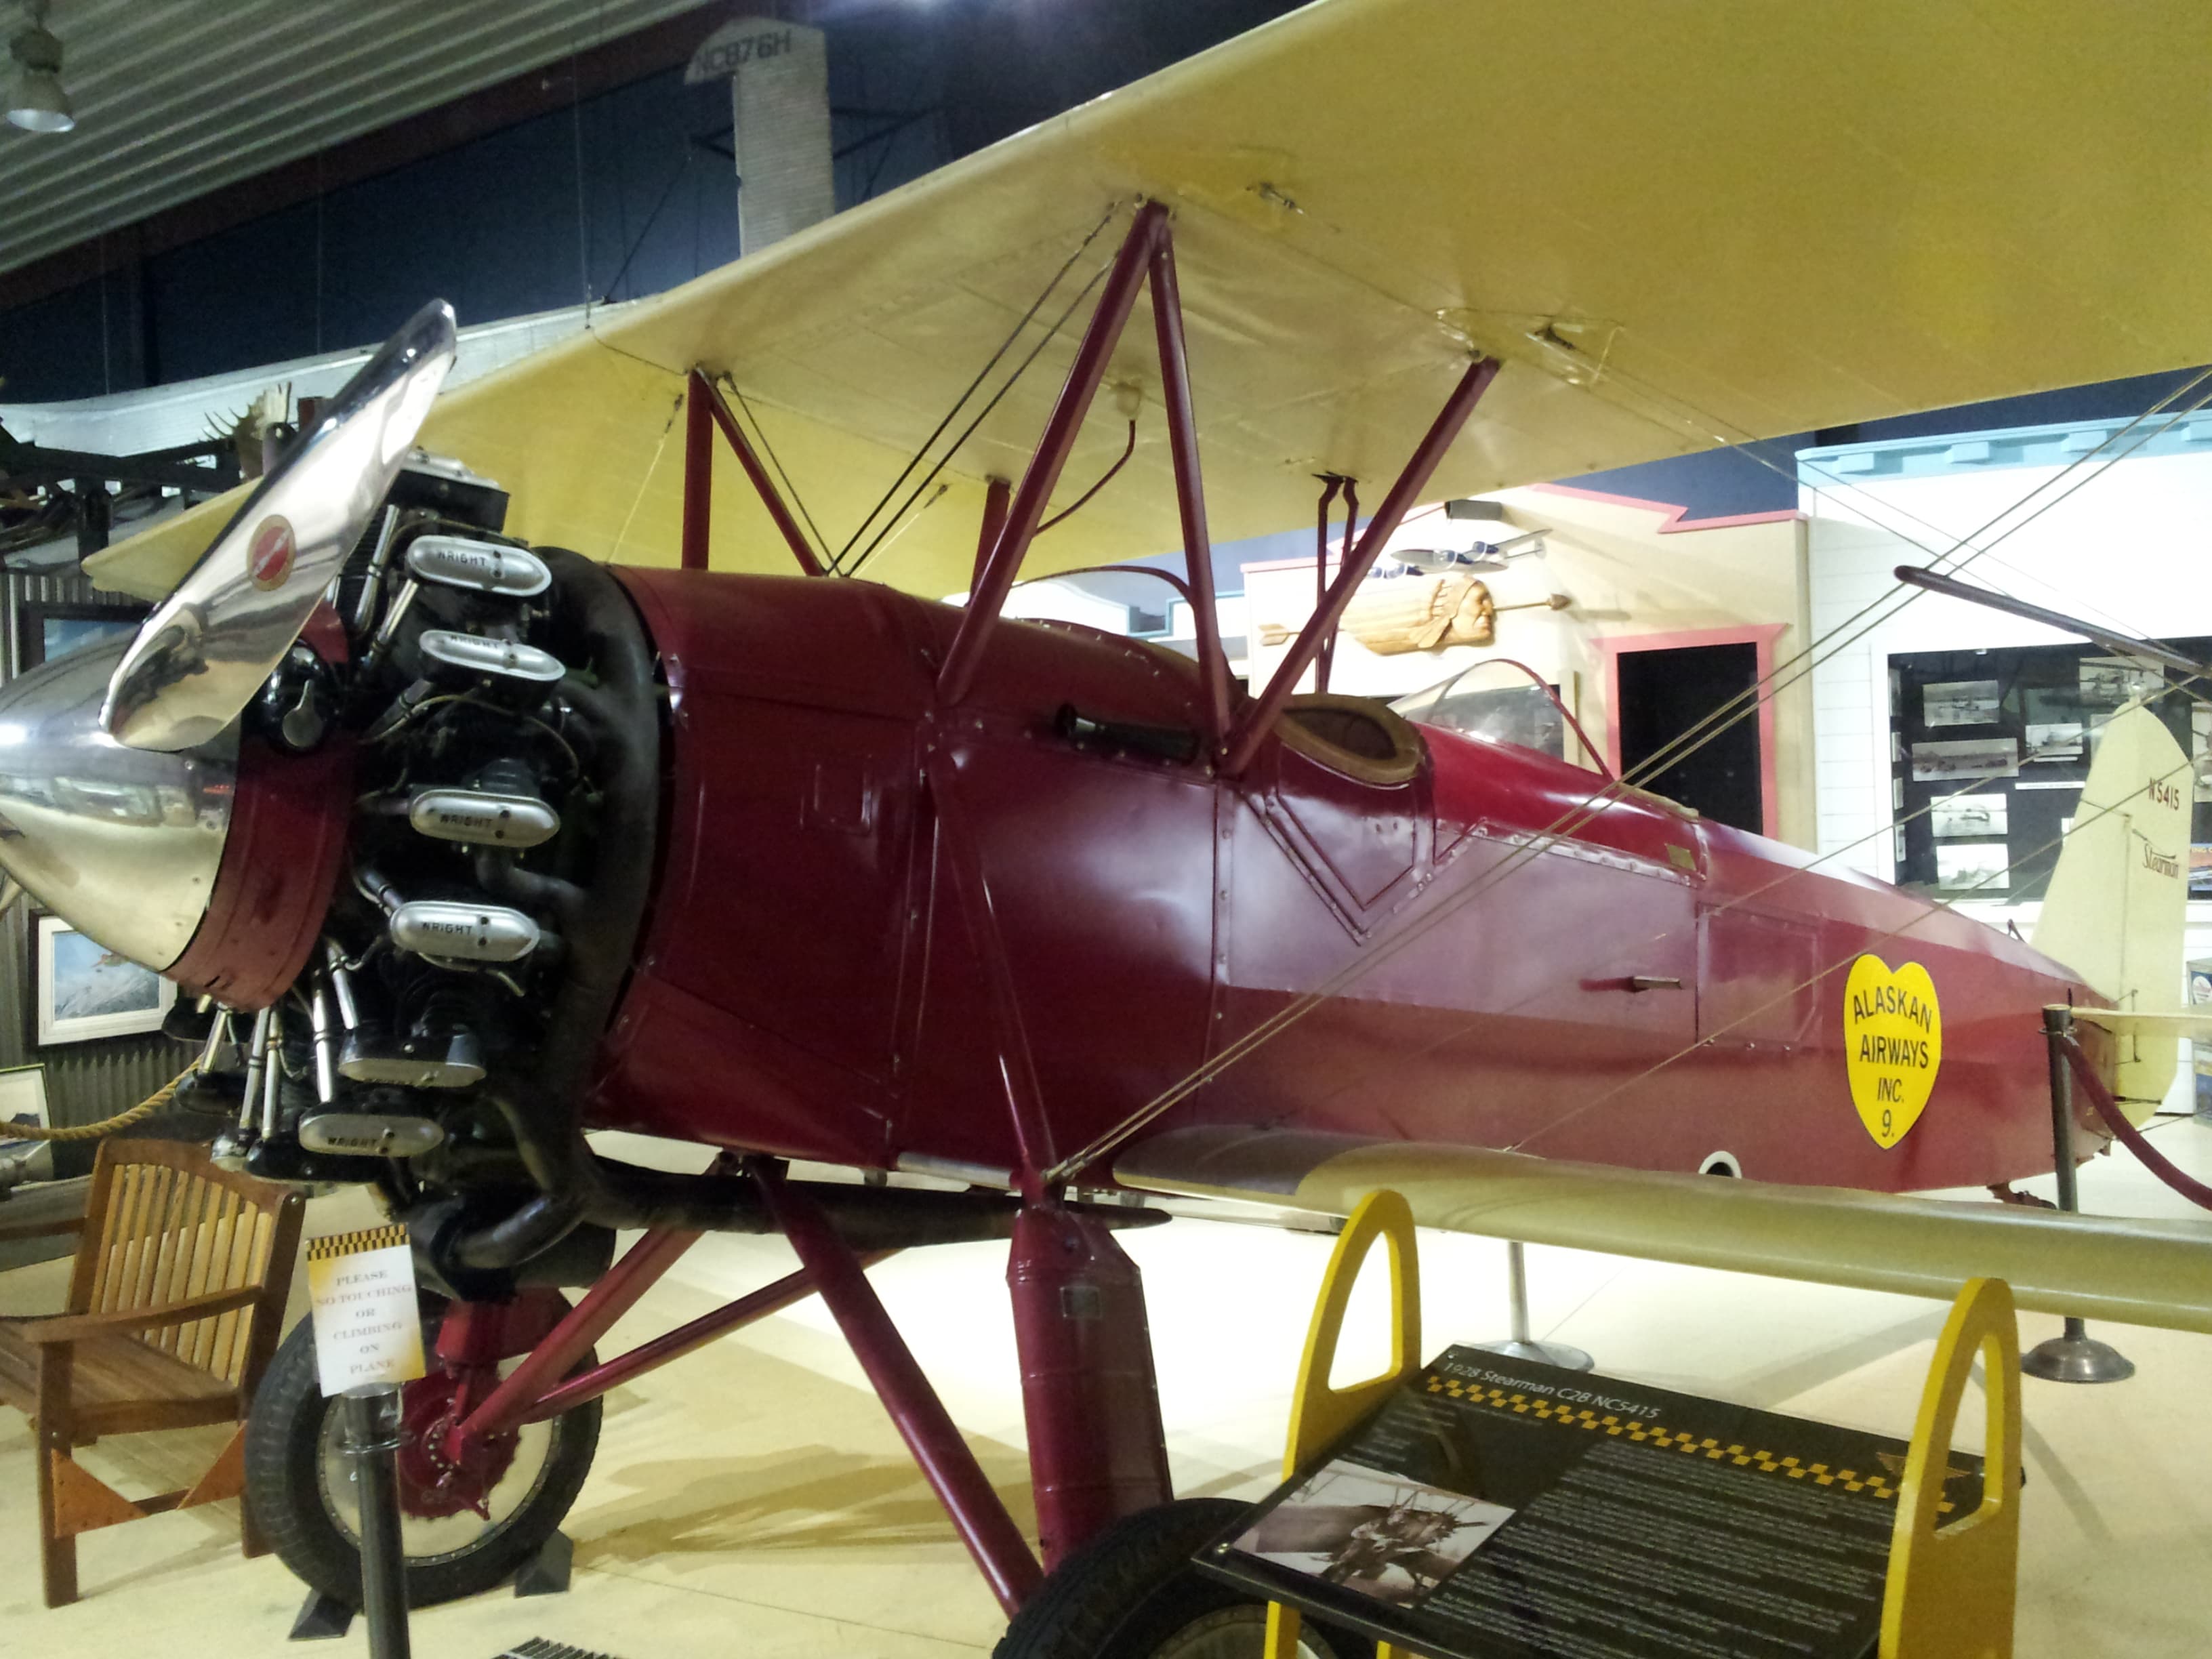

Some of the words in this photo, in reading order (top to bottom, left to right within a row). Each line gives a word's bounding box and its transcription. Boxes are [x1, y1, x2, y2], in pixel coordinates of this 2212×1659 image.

[438, 550, 488, 567] WRIGHT
[2148, 777, 2180, 811] N5415
[440, 814, 493, 827] WRIGHT
[422, 922, 473, 935] WRIGHT
[1853, 985, 1932, 1034] ALASKAN
[1859, 1034, 1929, 1069] AIRWAYS
[337, 1270, 388, 1286] PLEASE
[316, 1297, 336, 1306] NO
[340, 1285, 412, 1303] TOUCHING
[356, 1309, 375, 1318] OR
[333, 1322, 402, 1340] CLIMBING
[360, 1344, 380, 1354] ON
[350, 1359, 395, 1374] PLANE
[1443, 1362, 1481, 1378] 1928
[1480, 1370, 1556, 1396] Stearman
[1557, 1387, 1594, 1403] C2B
[1593, 1395, 1661, 1419] NC5415
